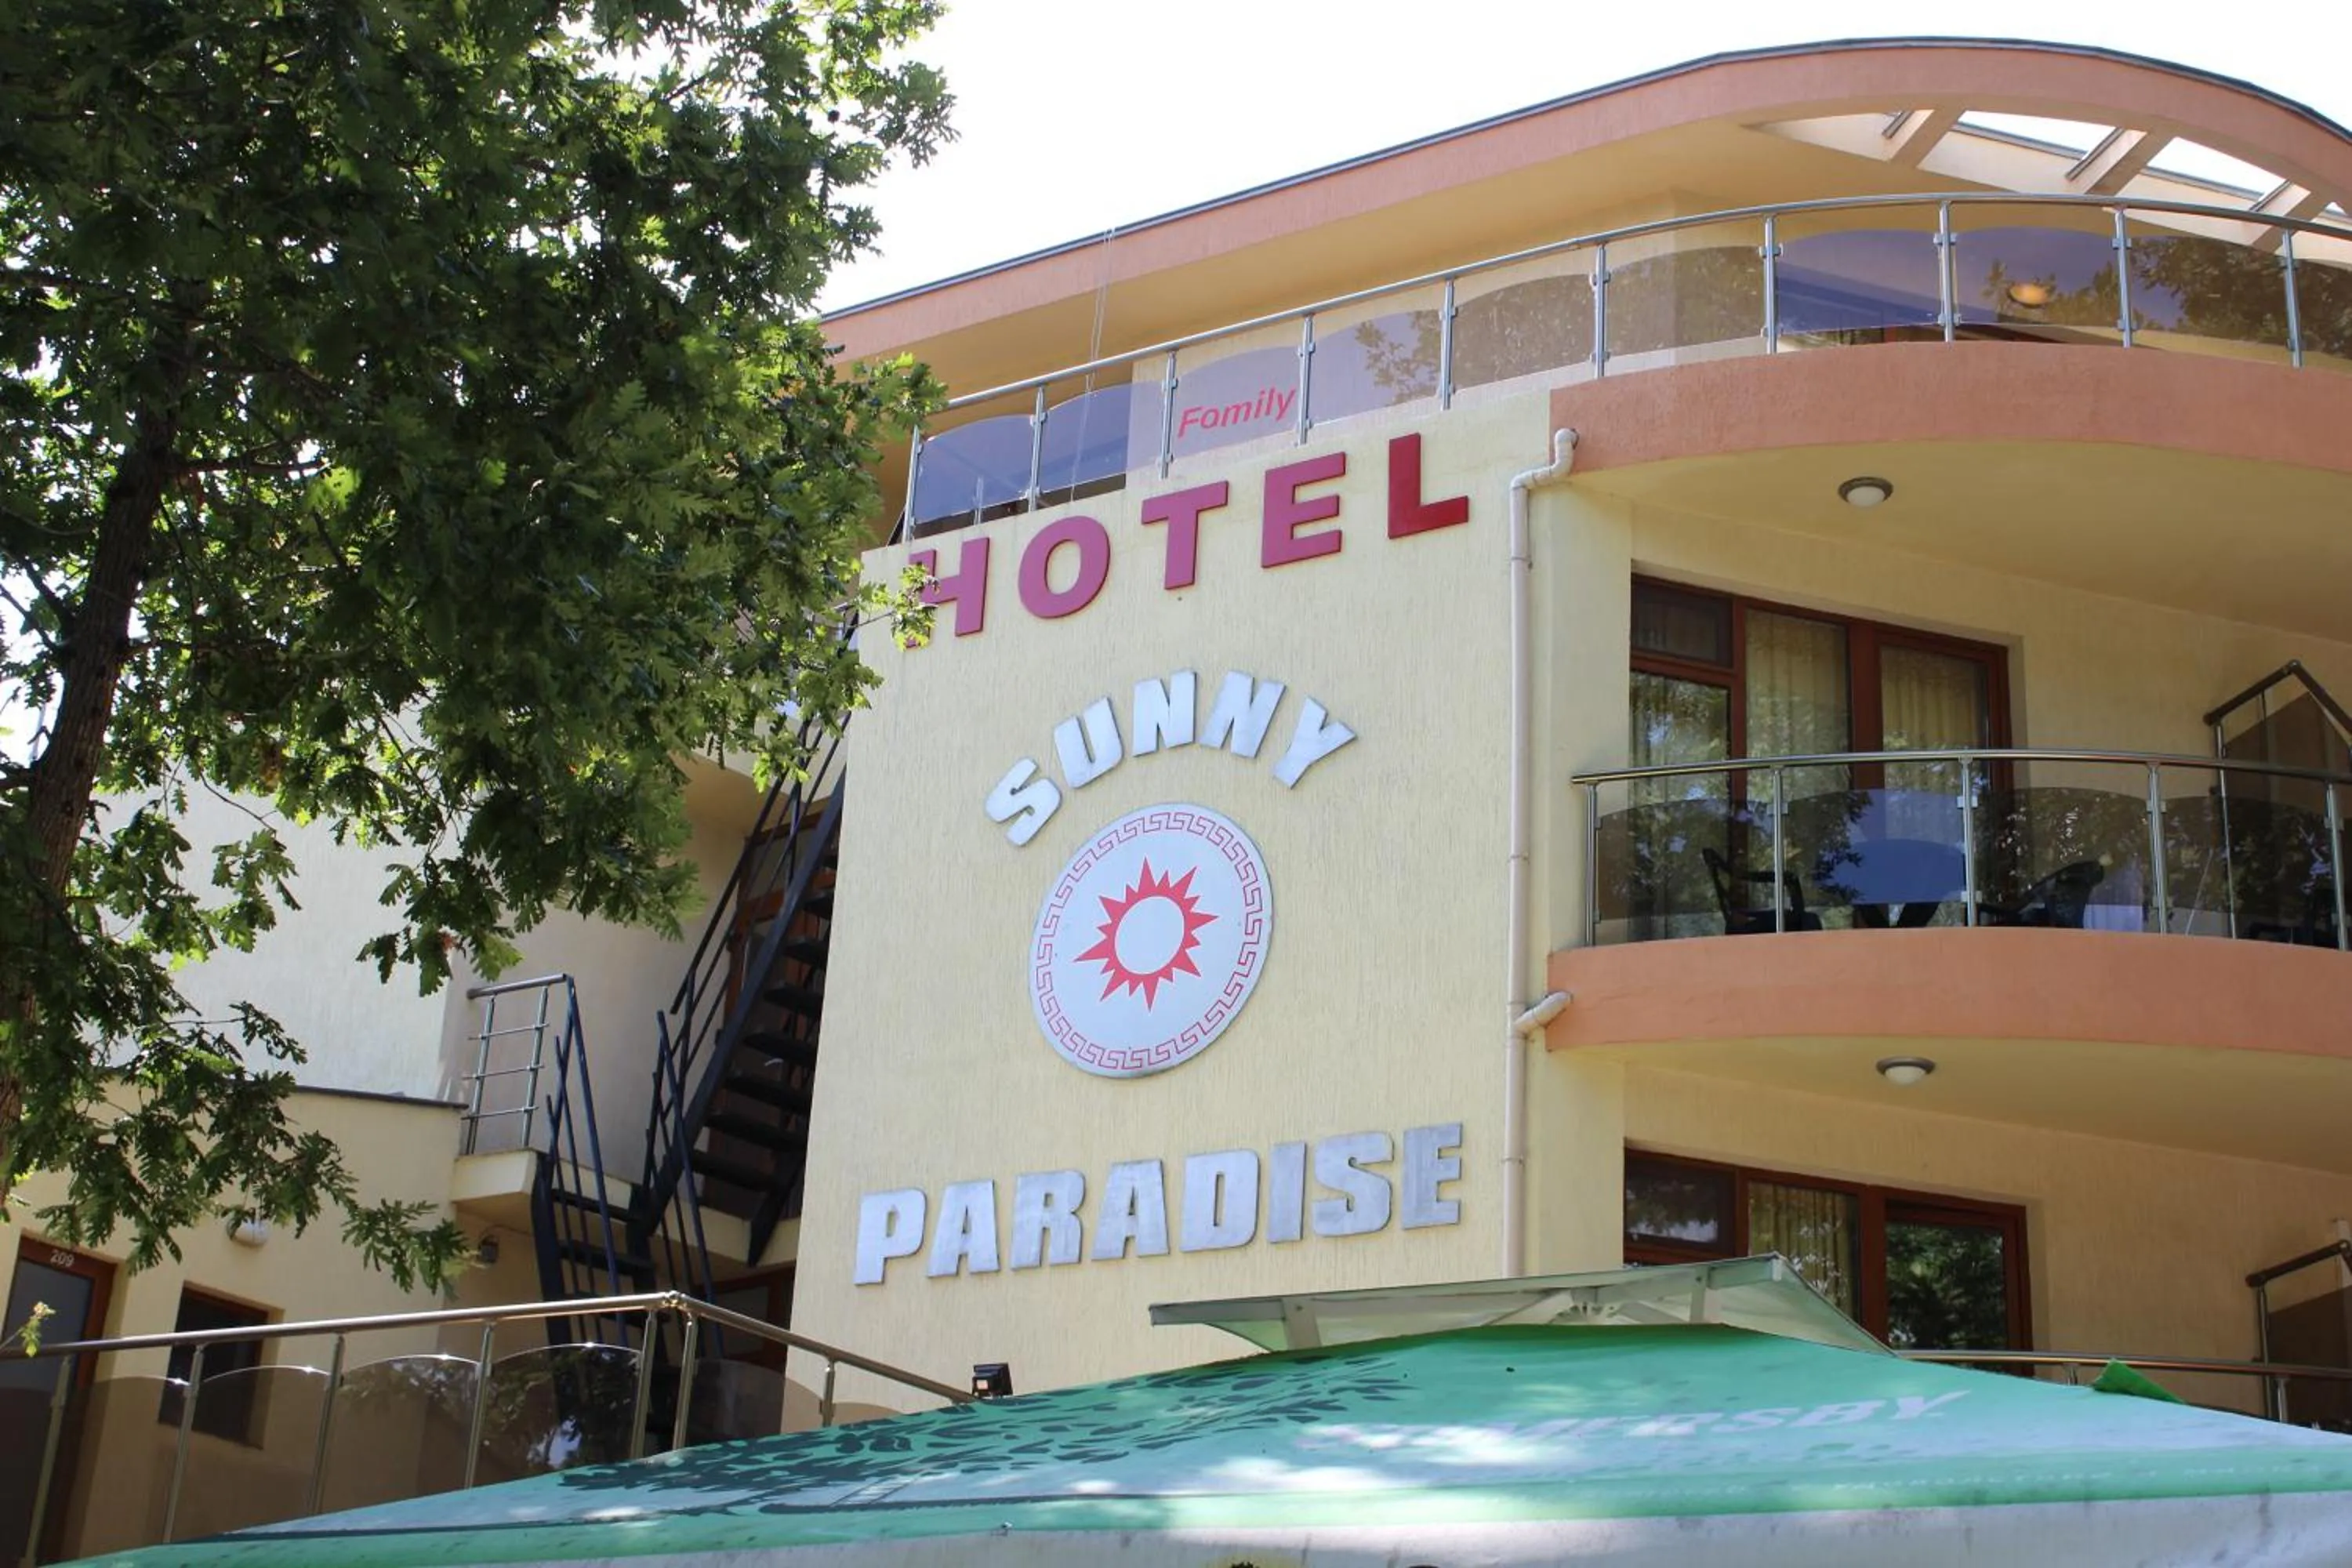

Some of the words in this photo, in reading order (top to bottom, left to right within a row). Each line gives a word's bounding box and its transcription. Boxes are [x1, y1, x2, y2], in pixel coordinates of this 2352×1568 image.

[1178, 386, 1297, 438] Family
[906, 431, 1469, 649] HOTEL
[984, 668, 1359, 848] SUNNY
[49, 1248, 75, 1268] 209
[853, 1121, 1464, 1287] PARADISE
